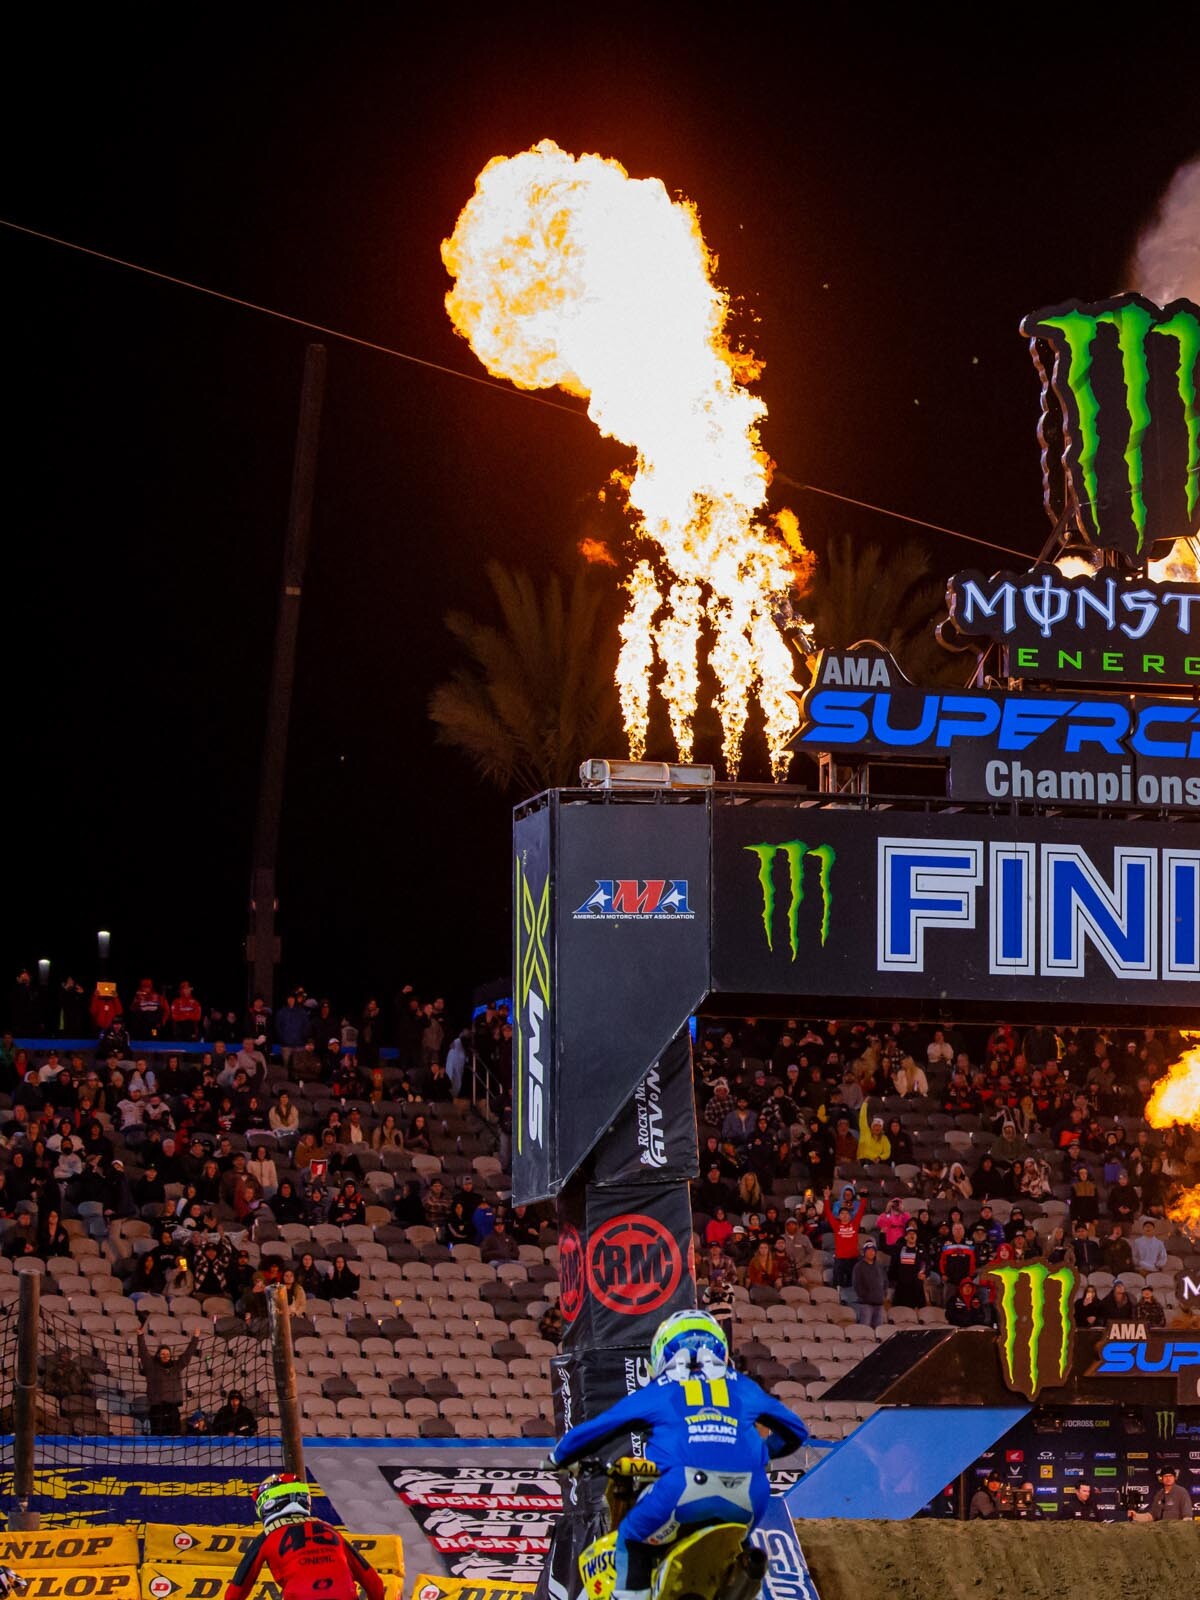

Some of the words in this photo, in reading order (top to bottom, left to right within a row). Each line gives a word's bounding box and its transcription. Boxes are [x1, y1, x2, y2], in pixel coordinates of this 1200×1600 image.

[822, 656, 890, 687] AMA
[572, 880, 695, 914] AMA
[638, 1104, 648, 1147] ROCKY
[603, 1244, 663, 1285] RM
[1109, 1323, 1147, 1340] AMA
[679, 1378, 730, 1408] 11
[687, 1424, 737, 1436] SUZUKI
[279, 1524, 340, 1556] 45
